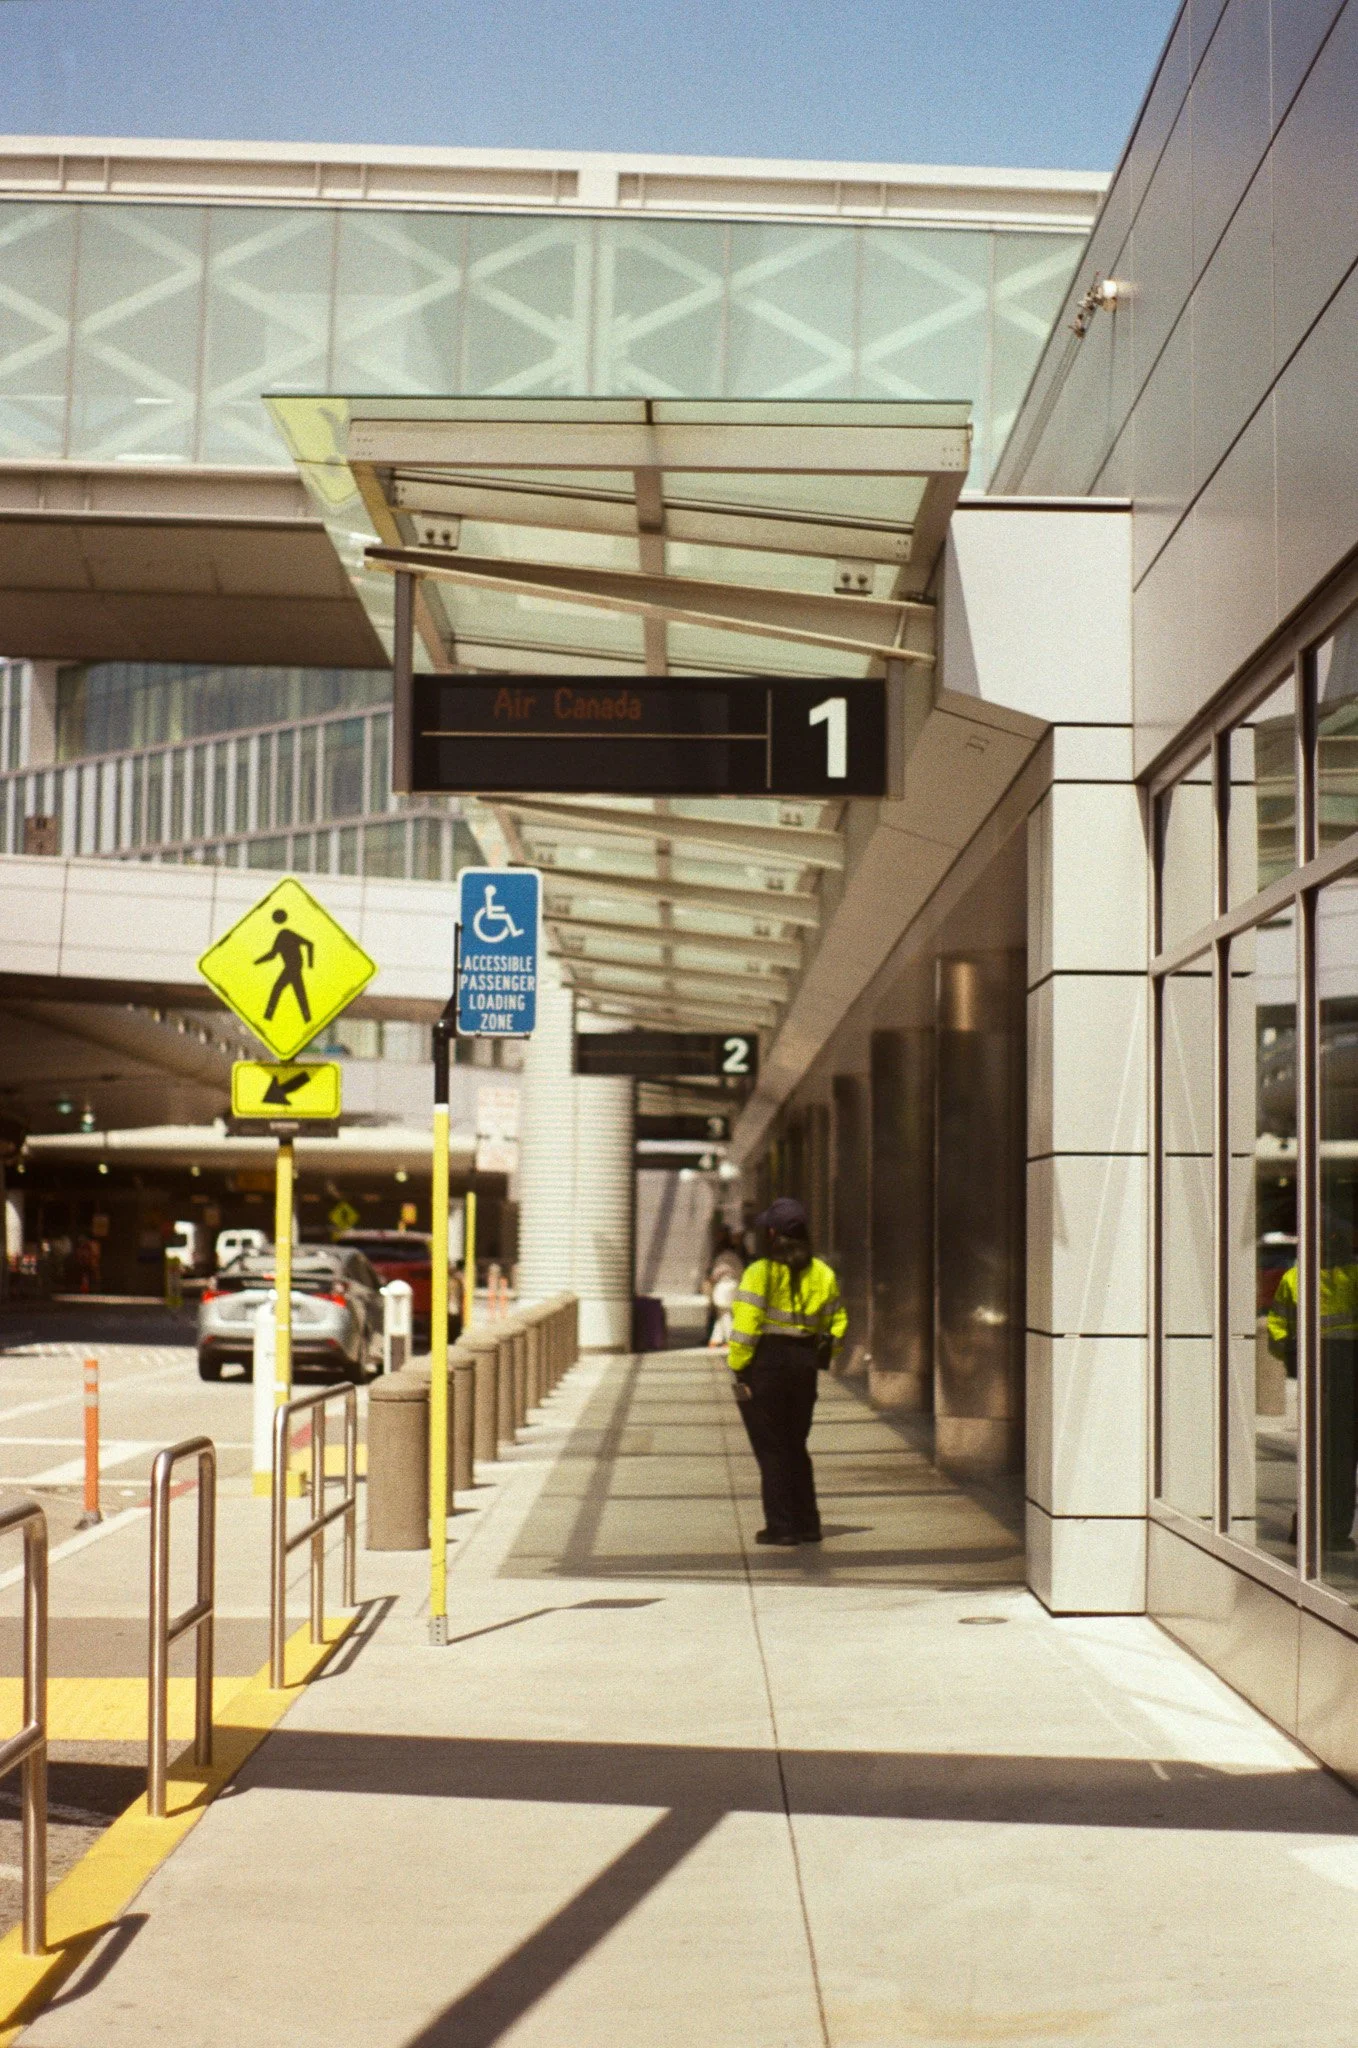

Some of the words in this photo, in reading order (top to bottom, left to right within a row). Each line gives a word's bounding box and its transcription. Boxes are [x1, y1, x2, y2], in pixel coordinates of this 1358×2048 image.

[494, 687, 536, 719] Air
[554, 687, 642, 720] Canada
[808, 697, 848, 778] 1
[464, 956, 532, 972] ACCESSIBLE
[460, 974, 535, 991] PASSENGER
[469, 993, 525, 1011] LOADING
[480, 1012, 514, 1030] ZONE
[723, 1037, 749, 1072] 2
